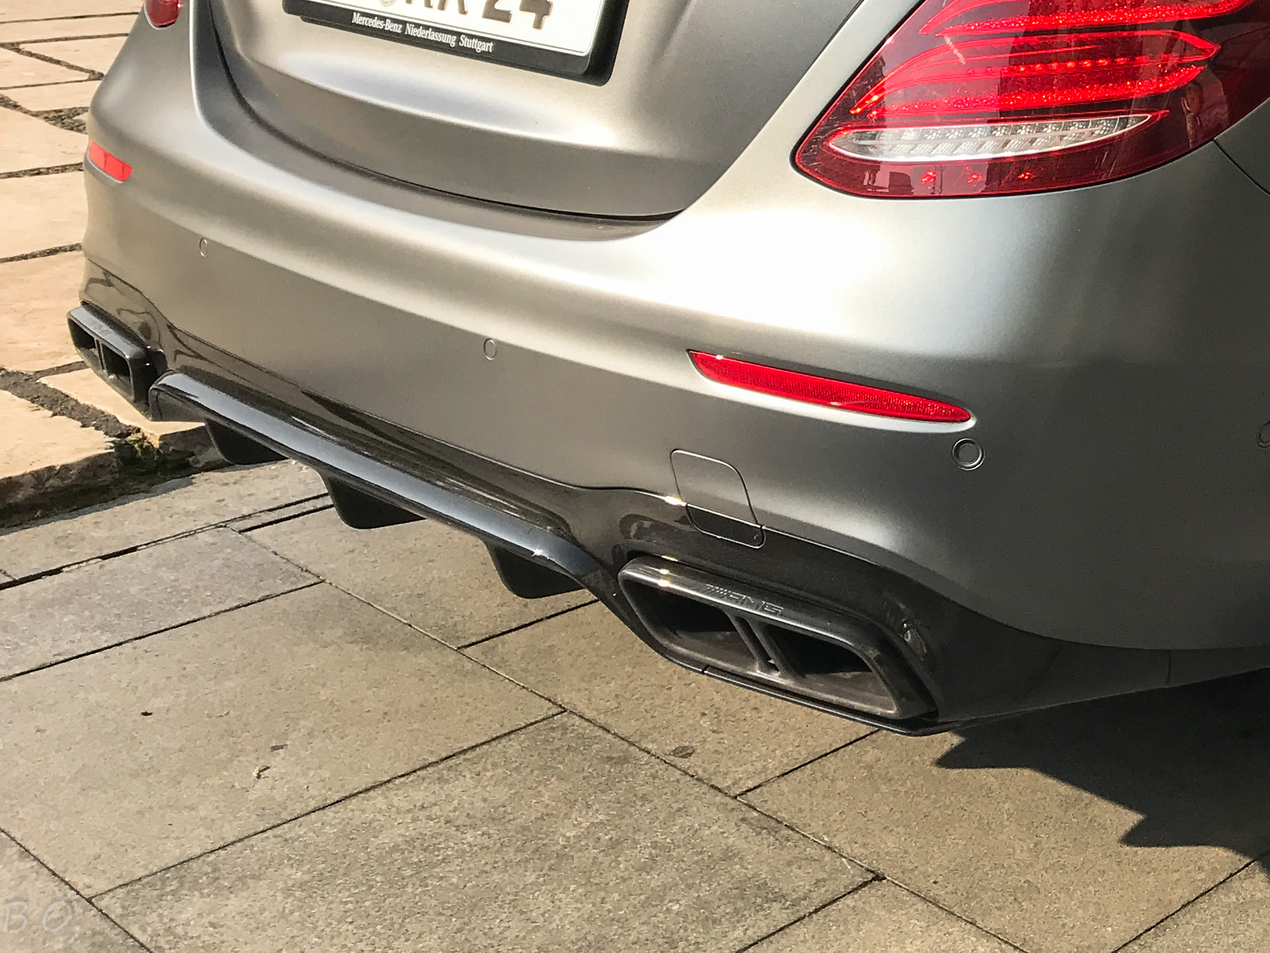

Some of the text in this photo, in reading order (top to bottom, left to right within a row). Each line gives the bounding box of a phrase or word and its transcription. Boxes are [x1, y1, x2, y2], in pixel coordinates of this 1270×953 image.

[351, 11, 494, 53] Mercedes-Benz Niederlassung Stuttgart
